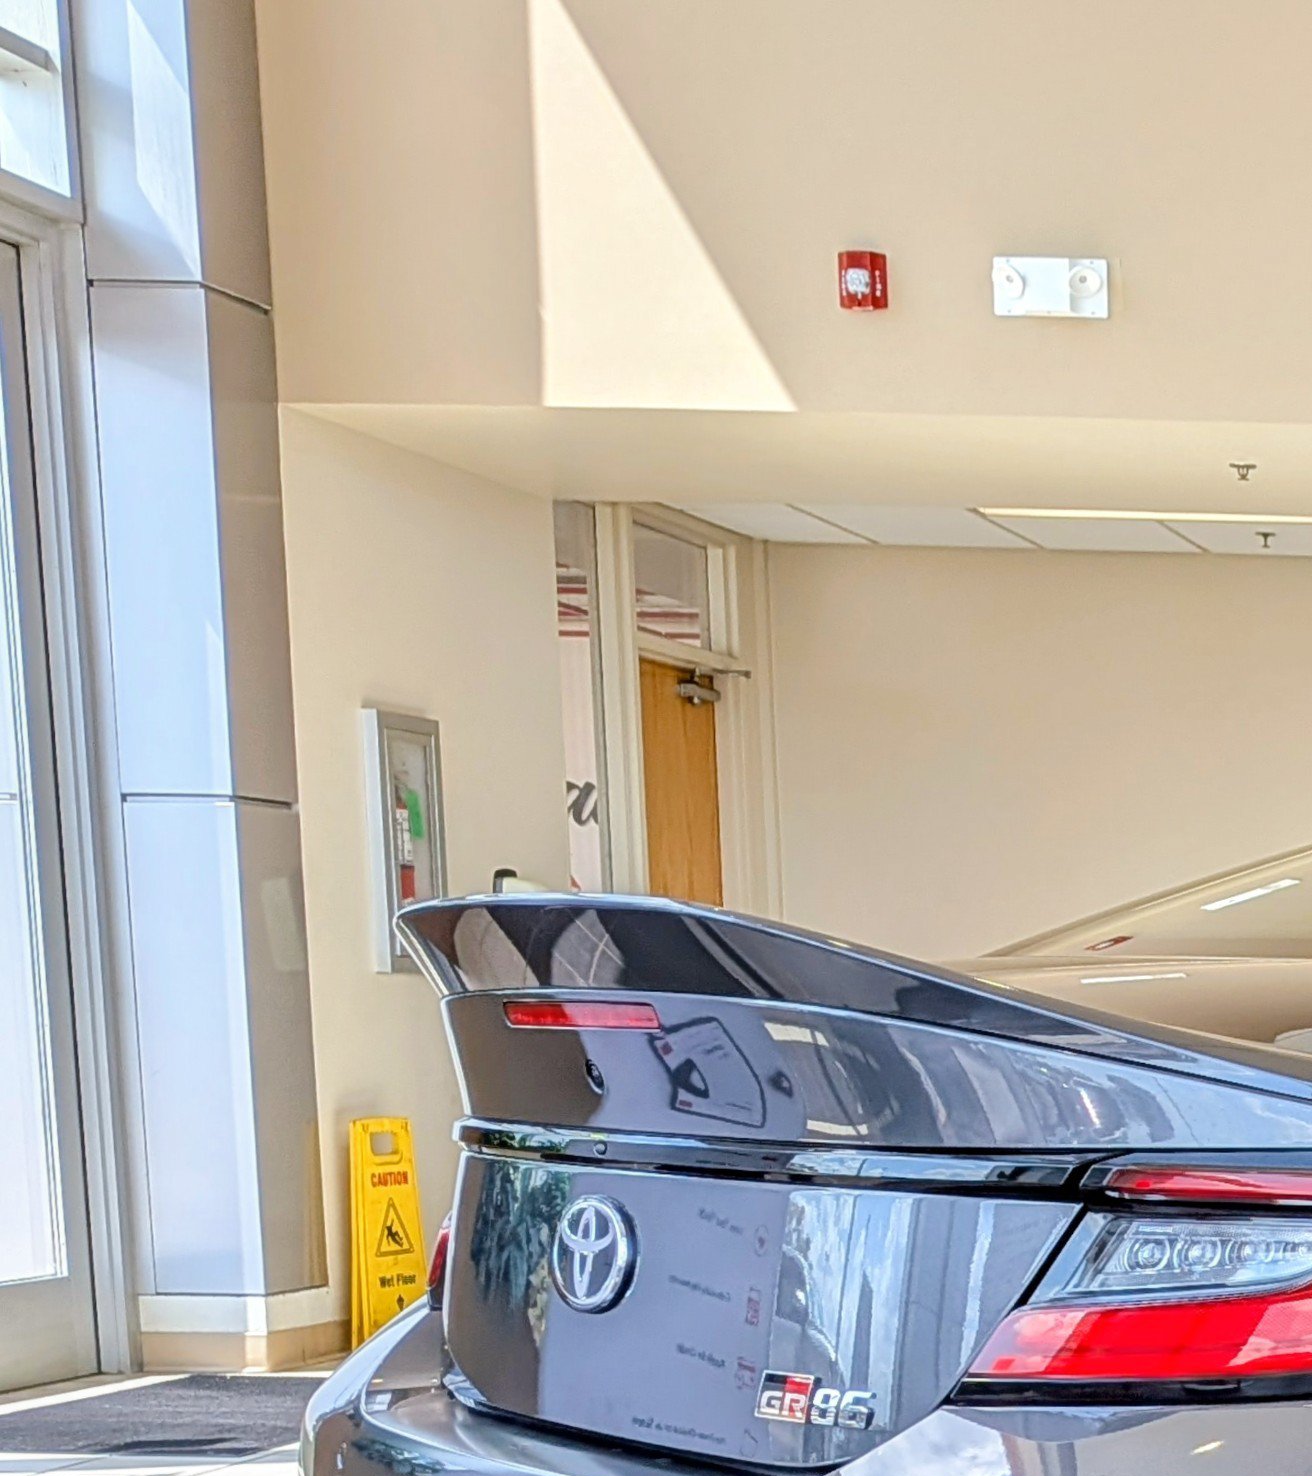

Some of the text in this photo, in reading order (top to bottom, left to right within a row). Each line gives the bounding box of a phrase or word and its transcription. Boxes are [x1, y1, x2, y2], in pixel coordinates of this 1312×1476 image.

[371, 1171, 409, 1188] CAUTION
[379, 1273, 416, 1289] Wet Floor
[760, 1387, 877, 1430] GR 86
